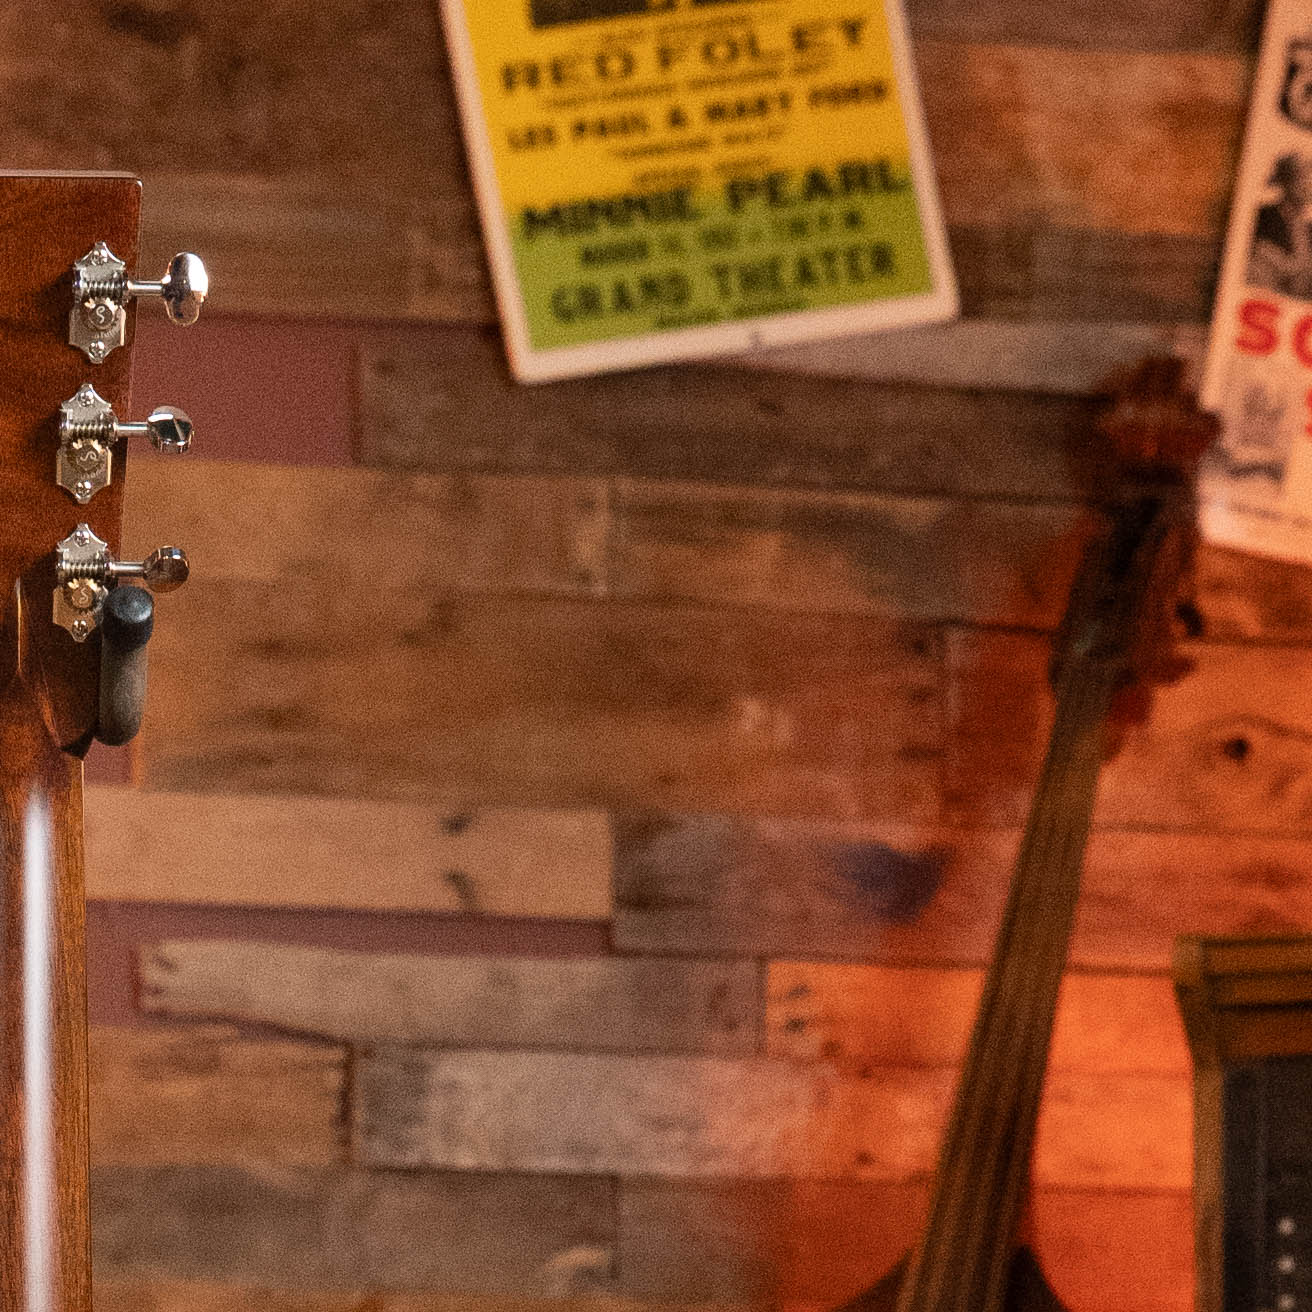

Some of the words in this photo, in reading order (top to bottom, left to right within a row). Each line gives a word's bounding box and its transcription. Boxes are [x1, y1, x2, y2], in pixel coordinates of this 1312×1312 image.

[500, 47, 635, 93] RED
[656, 17, 865, 71] FOLEY
[522, 187, 699, 239] MINNIE
[726, 161, 910, 213] PEARL
[553, 272, 689, 324] GRAND
[713, 241, 894, 297] THEATER
